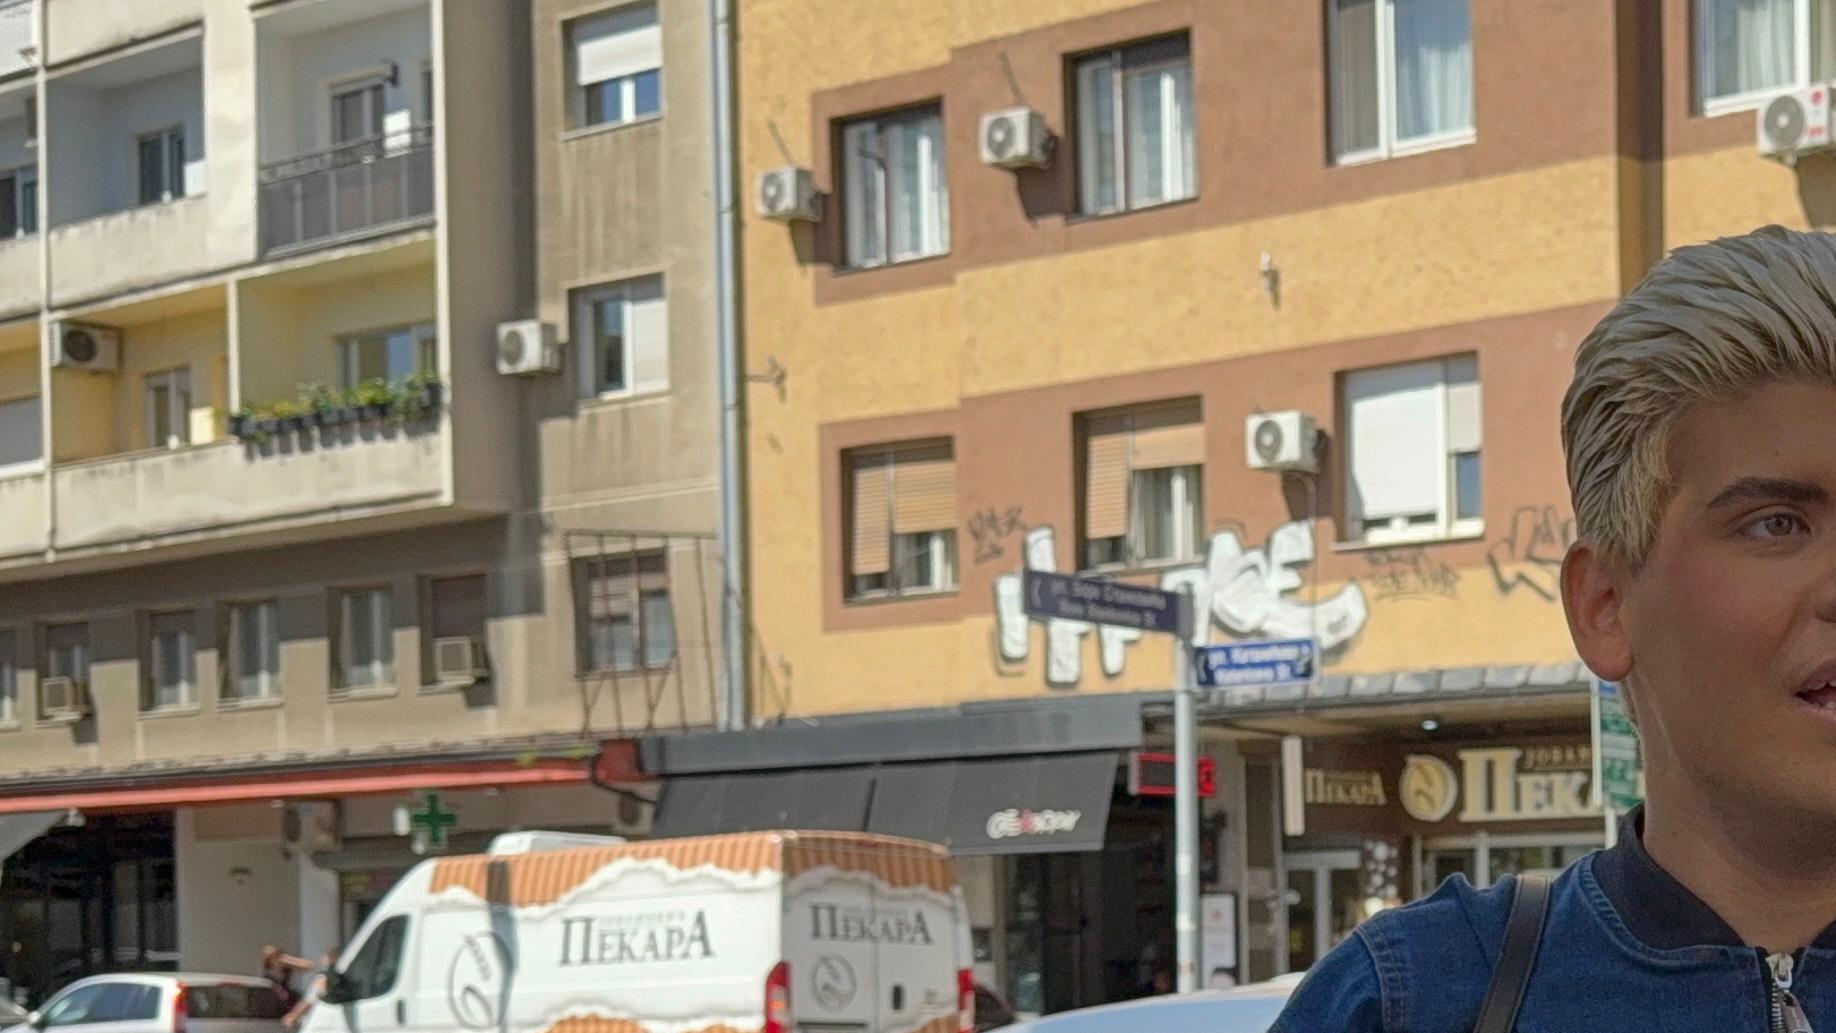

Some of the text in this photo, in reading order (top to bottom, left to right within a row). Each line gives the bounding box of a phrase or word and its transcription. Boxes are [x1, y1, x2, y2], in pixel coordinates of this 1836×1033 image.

[1458, 748, 1605, 822] ПЕК
[559, 909, 717, 967] ПЕКАРА
[810, 902, 934, 945] ПЕКАРА
